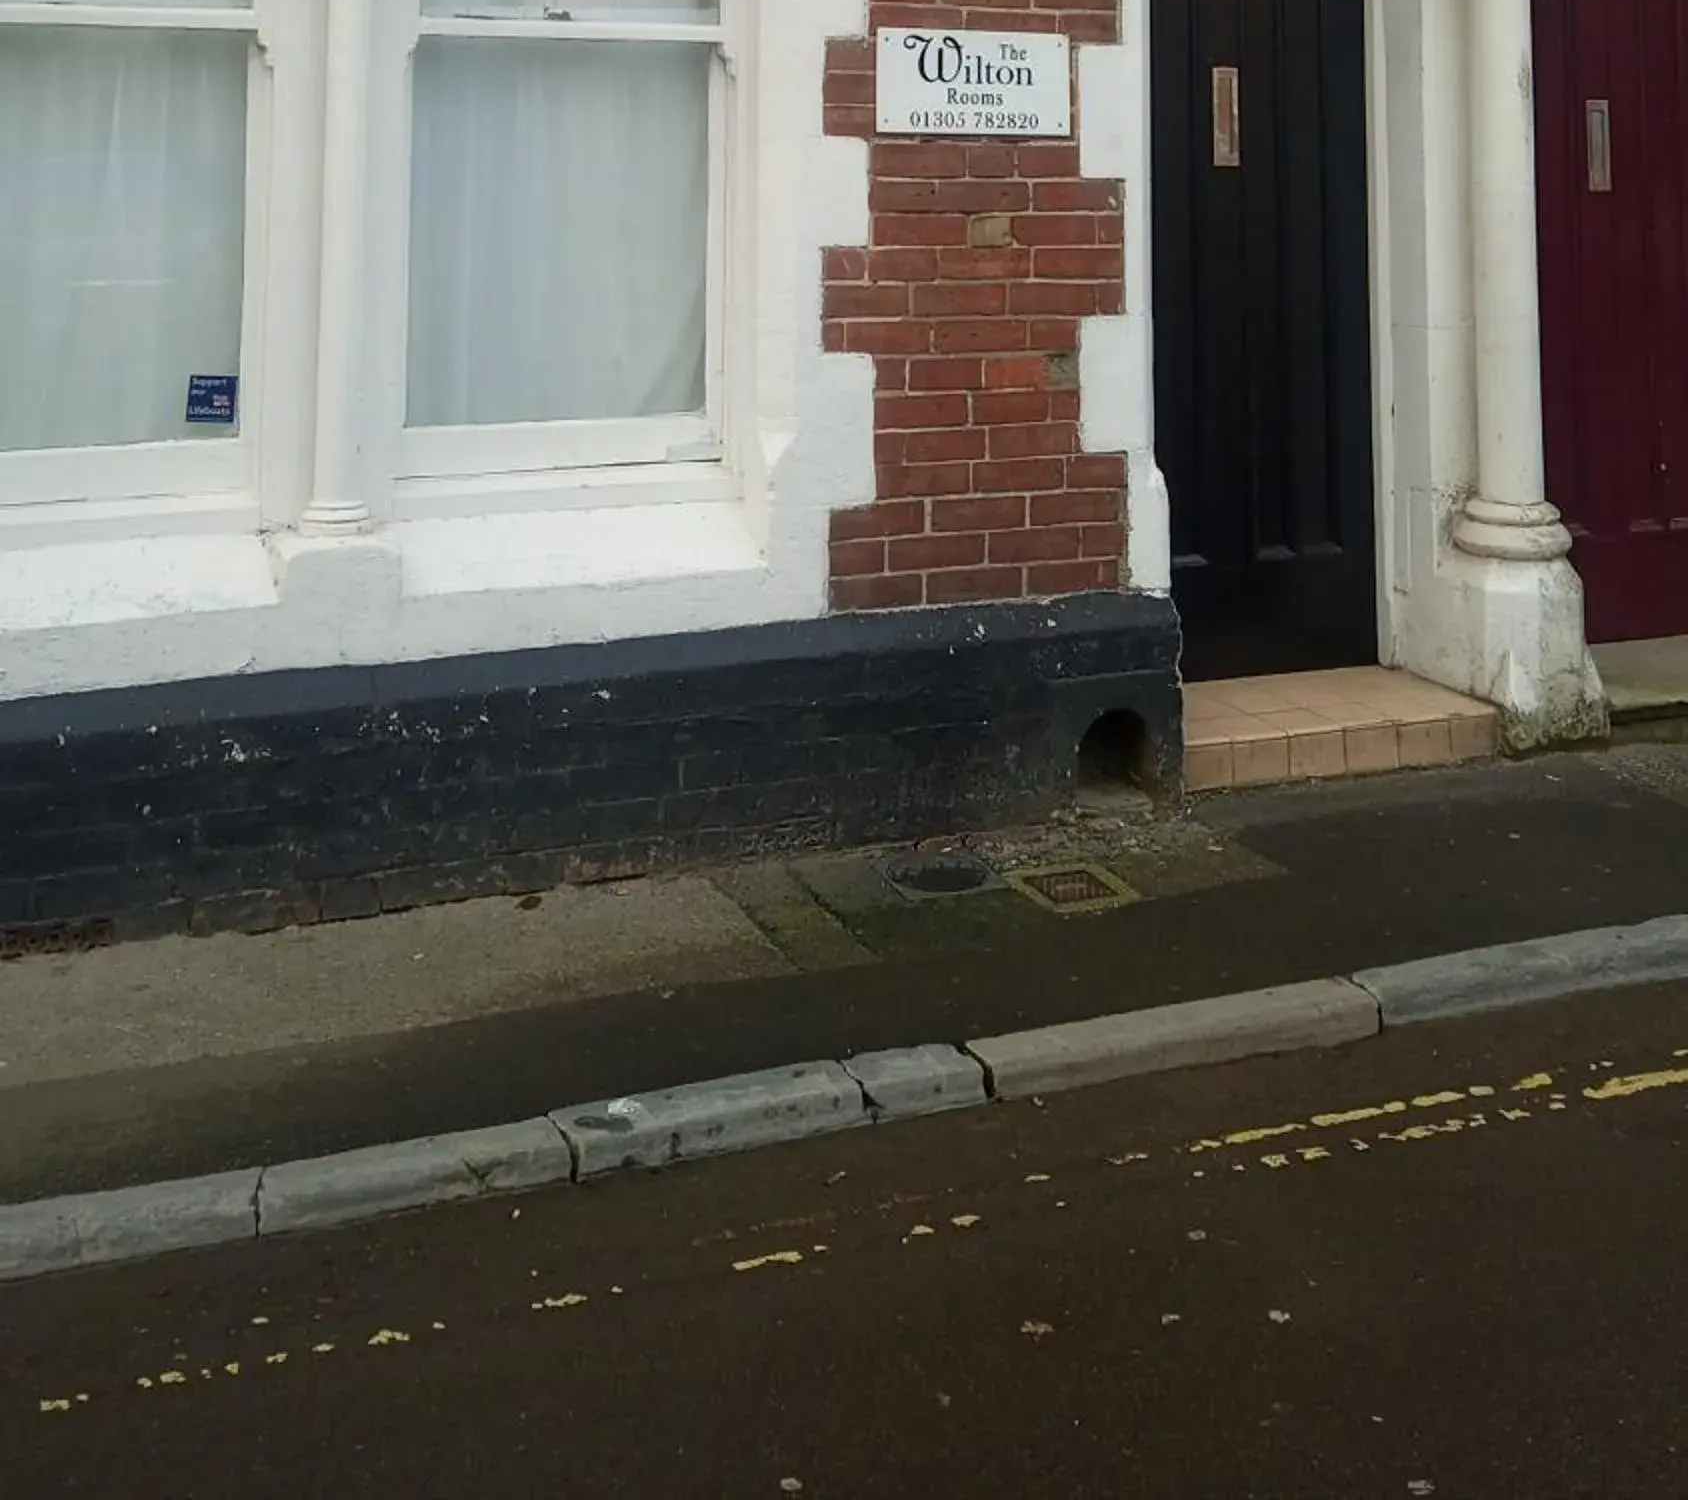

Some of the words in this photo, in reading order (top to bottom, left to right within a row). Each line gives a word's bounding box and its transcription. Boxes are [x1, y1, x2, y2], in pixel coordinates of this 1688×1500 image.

[903, 34, 1034, 85] Wilton
[999, 43, 1028, 61] The
[947, 87, 1004, 106] Rooms
[909, 110, 966, 128] 01305
[974, 111, 1039, 130] 782820
